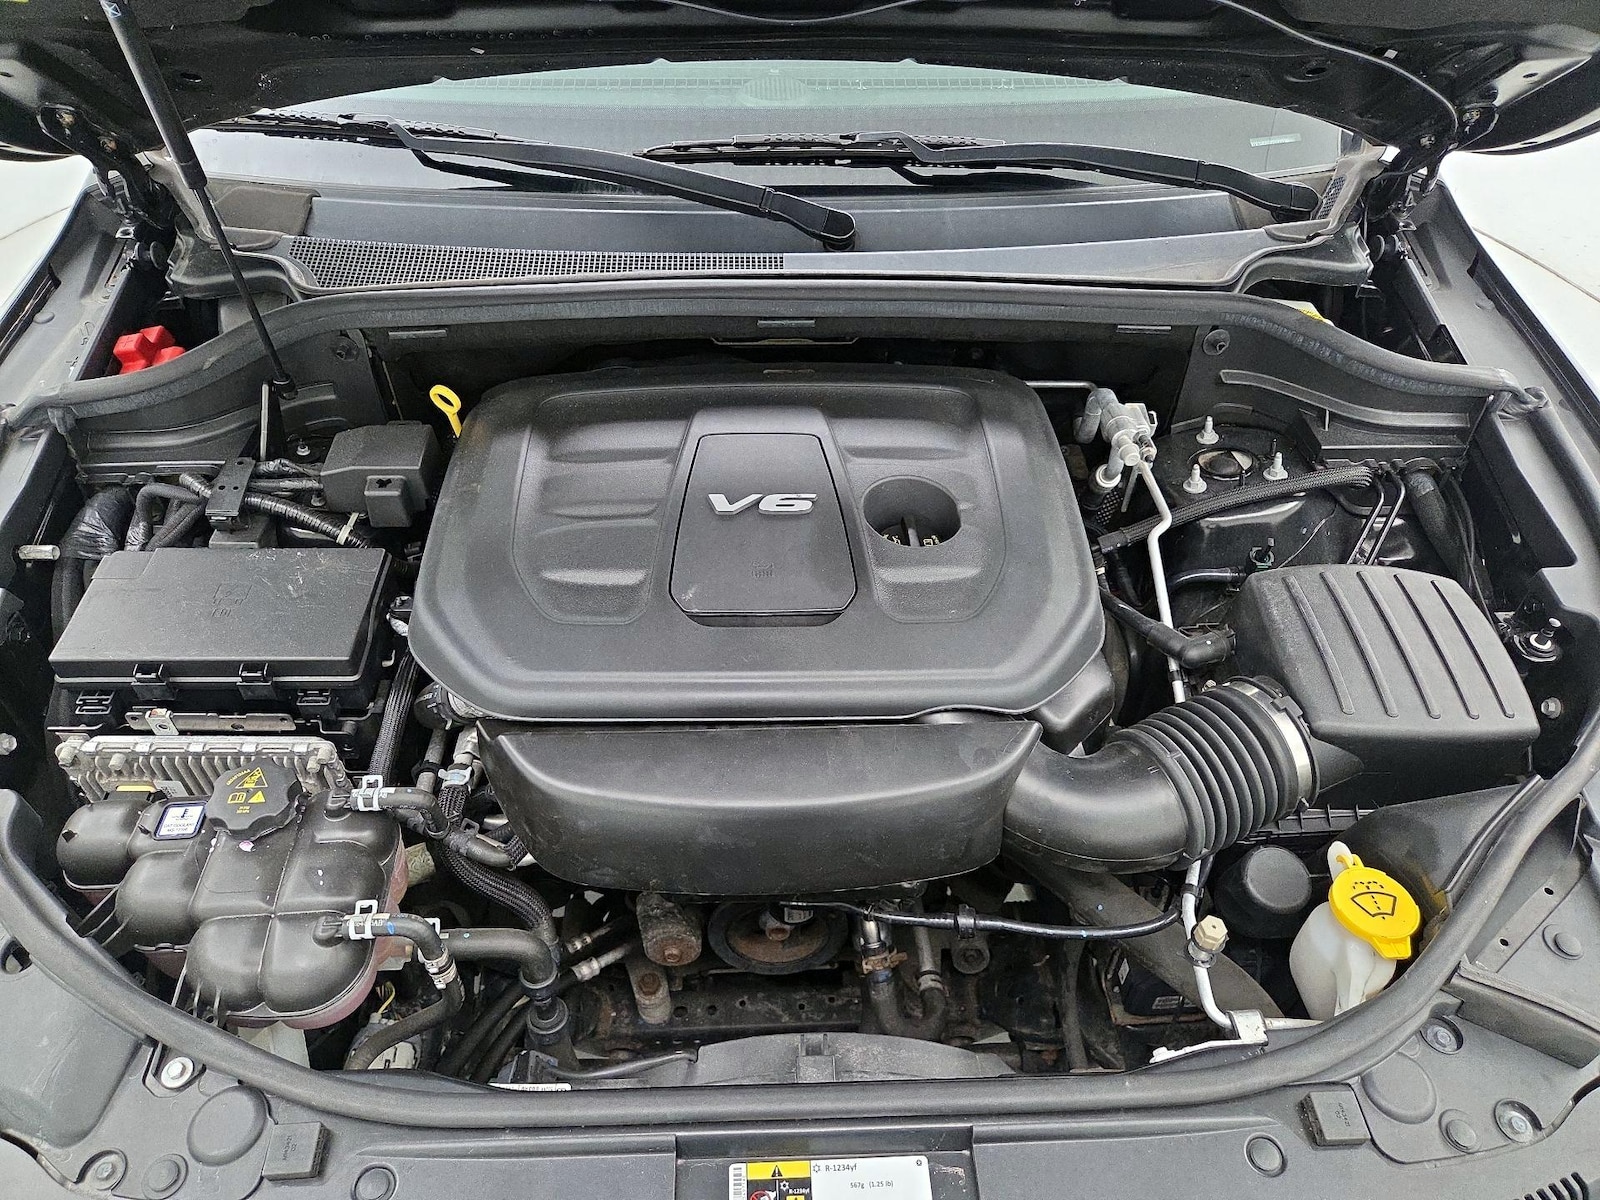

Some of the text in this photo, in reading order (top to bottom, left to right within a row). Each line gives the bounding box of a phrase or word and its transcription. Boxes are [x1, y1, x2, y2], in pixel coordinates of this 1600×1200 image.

[707, 493, 818, 515] V6
[825, 1163, 857, 1172] R-1234yf
[850, 1180, 894, 1189] 567g (1.25 lb)
